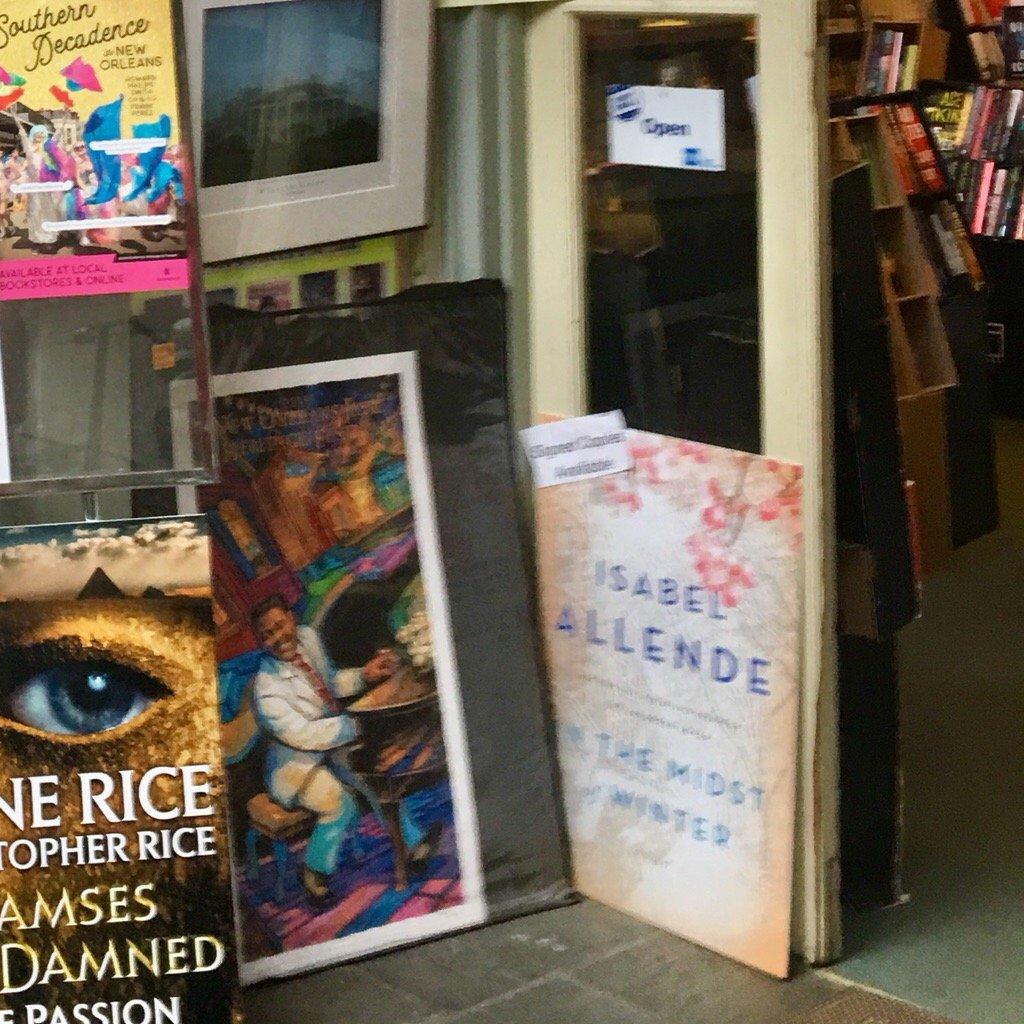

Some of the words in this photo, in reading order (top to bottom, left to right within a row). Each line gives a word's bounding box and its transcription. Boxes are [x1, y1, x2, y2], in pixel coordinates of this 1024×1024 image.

[25, 18, 150, 71] Decadence
[100, 56, 162, 70] ORLEANS
[116, 44, 146, 56] NEW
[0, 265, 52, 278] AVAILABLE
[56, 265, 67, 274] AT
[72, 263, 107, 274] LOCAL
[0, 277, 72, 290] BOOKSTORES
[87, 275, 124, 285] ONLINE
[595, 559, 727, 620] ISABEL
[555, 605, 772, 697] ALLENDE
[76, 764, 216, 825] RICE
[595, 732, 654, 772] THE
[667, 759, 765, 810] MIDST
[610, 784, 730, 849] WINTER
[138, 826, 217, 861] RICE
[0, 934, 227, 994] DAMNED
[25, 996, 181, 1024] PASSION
